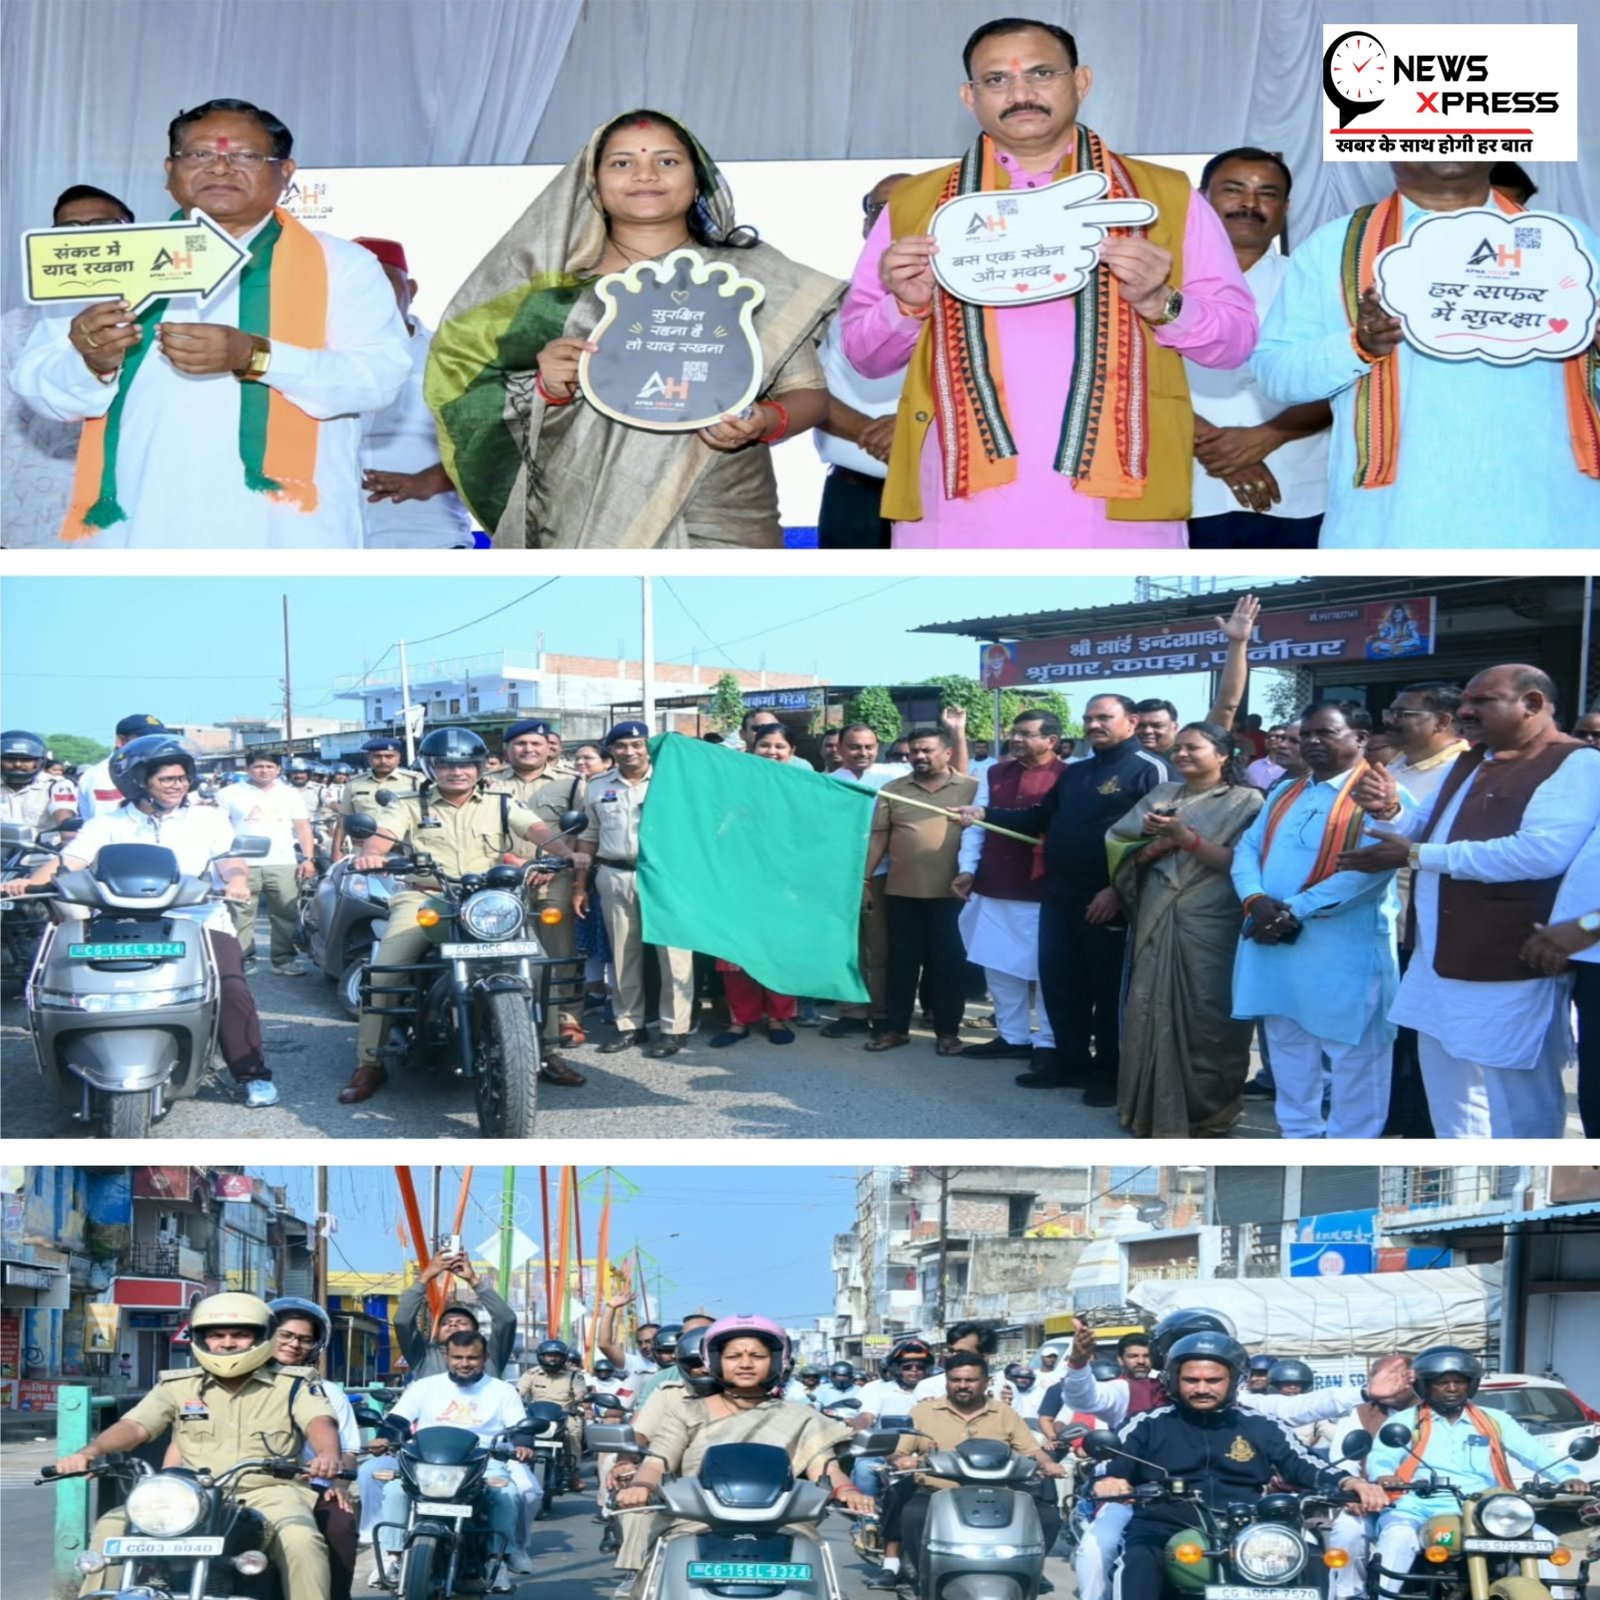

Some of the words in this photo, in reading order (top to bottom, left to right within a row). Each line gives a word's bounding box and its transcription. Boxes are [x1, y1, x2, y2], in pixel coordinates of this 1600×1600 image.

[53, 243, 101, 260] संकट
[106, 240, 121, 257] में
[952, 253, 981, 267] बस
[985, 250, 1016, 265] एक
[1021, 244, 1066, 260] स्कैन
[42, 264, 77, 277] याद
[82, 260, 135, 275] रखना
[972, 267, 1005, 283] और
[1011, 264, 1052, 279] मदद
[1428, 282, 1470, 298] हर
[1473, 284, 1549, 303] सफर
[651, 307, 706, 323] सुरक्षित
[1431, 301, 1457, 321] में
[1461, 308, 1548, 330] सुरक्षा
[650, 326, 689, 337] रहना
[690, 323, 704, 338] है
[625, 338, 641, 351] तो
[646, 341, 676, 353] याद
[678, 343, 726, 354] रखना
[1069, 638, 1091, 657] श्री
